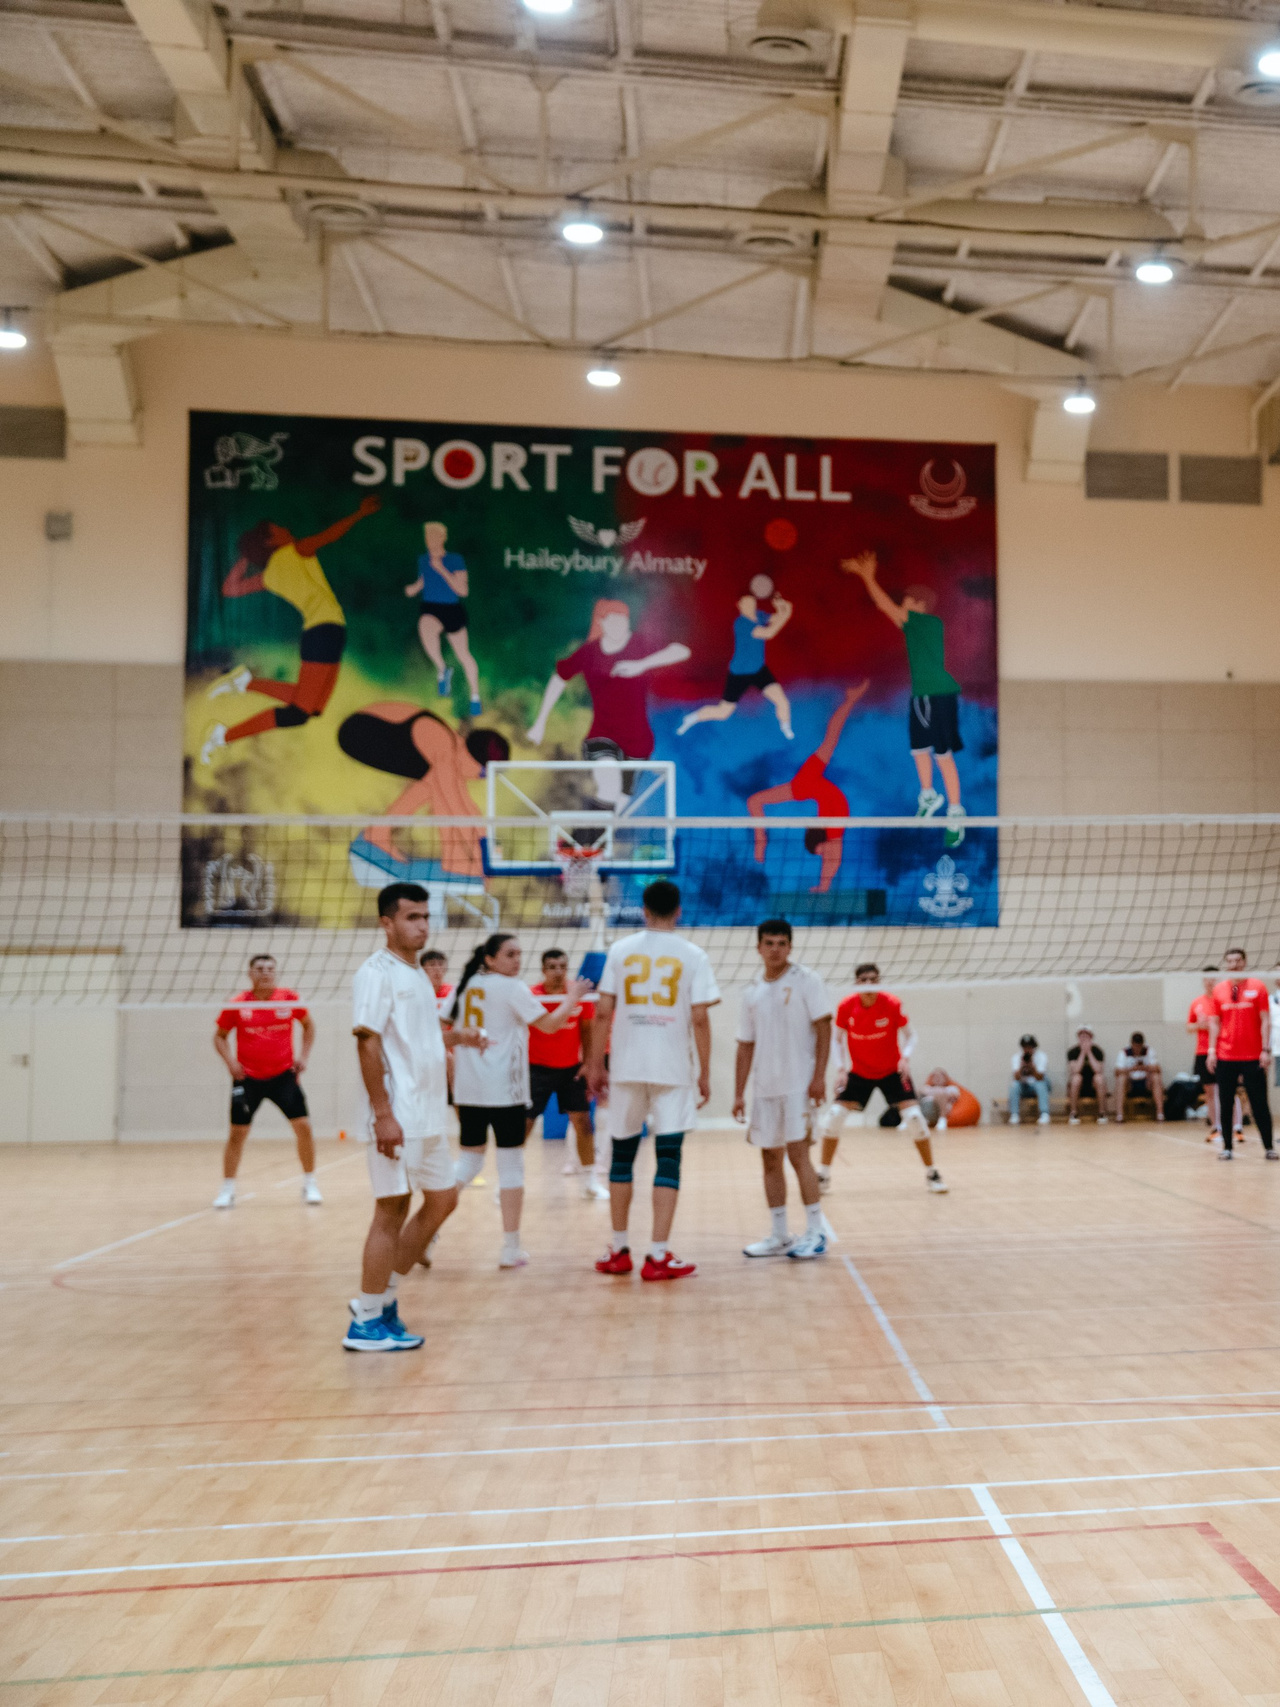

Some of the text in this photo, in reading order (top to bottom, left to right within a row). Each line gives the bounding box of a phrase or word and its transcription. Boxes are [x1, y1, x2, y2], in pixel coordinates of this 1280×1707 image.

[352, 435, 852, 502] SPORT FOR ALL
[504, 547, 708, 581] Haileybury Almaty
[623, 953, 684, 1008] 23
[464, 988, 486, 1028] 6
